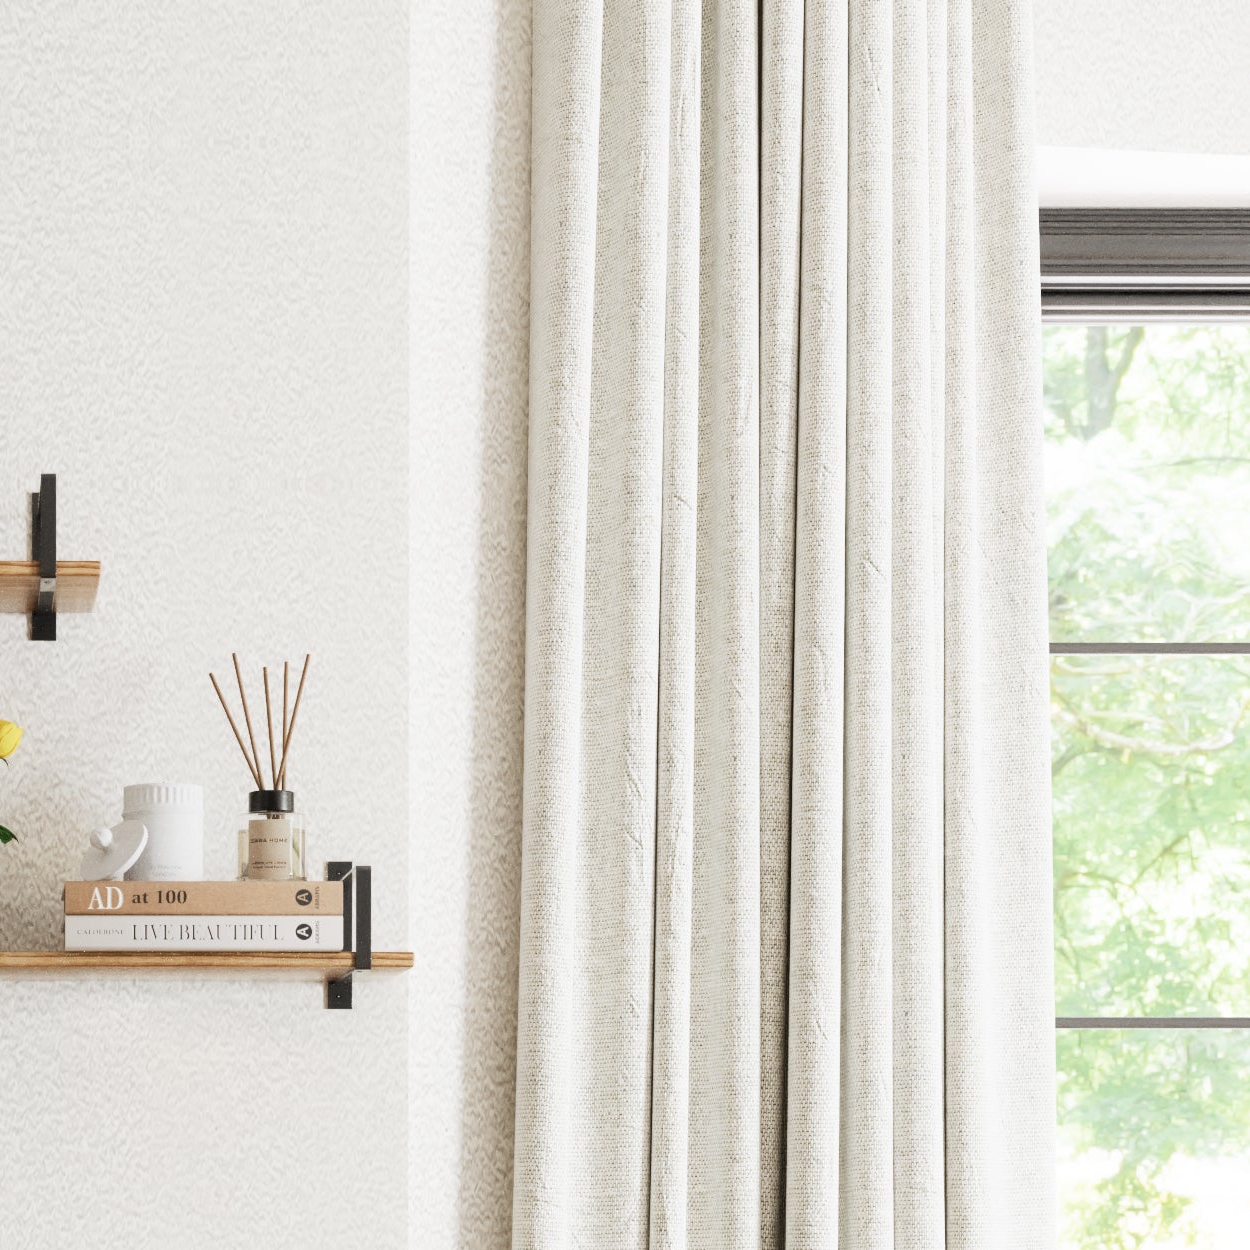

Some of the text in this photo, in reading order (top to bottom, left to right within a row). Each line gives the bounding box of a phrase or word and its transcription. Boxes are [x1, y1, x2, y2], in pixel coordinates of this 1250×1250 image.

[88, 887, 187, 910] AD at 100
[133, 925, 284, 940] LIVE BEAUTIFUL
